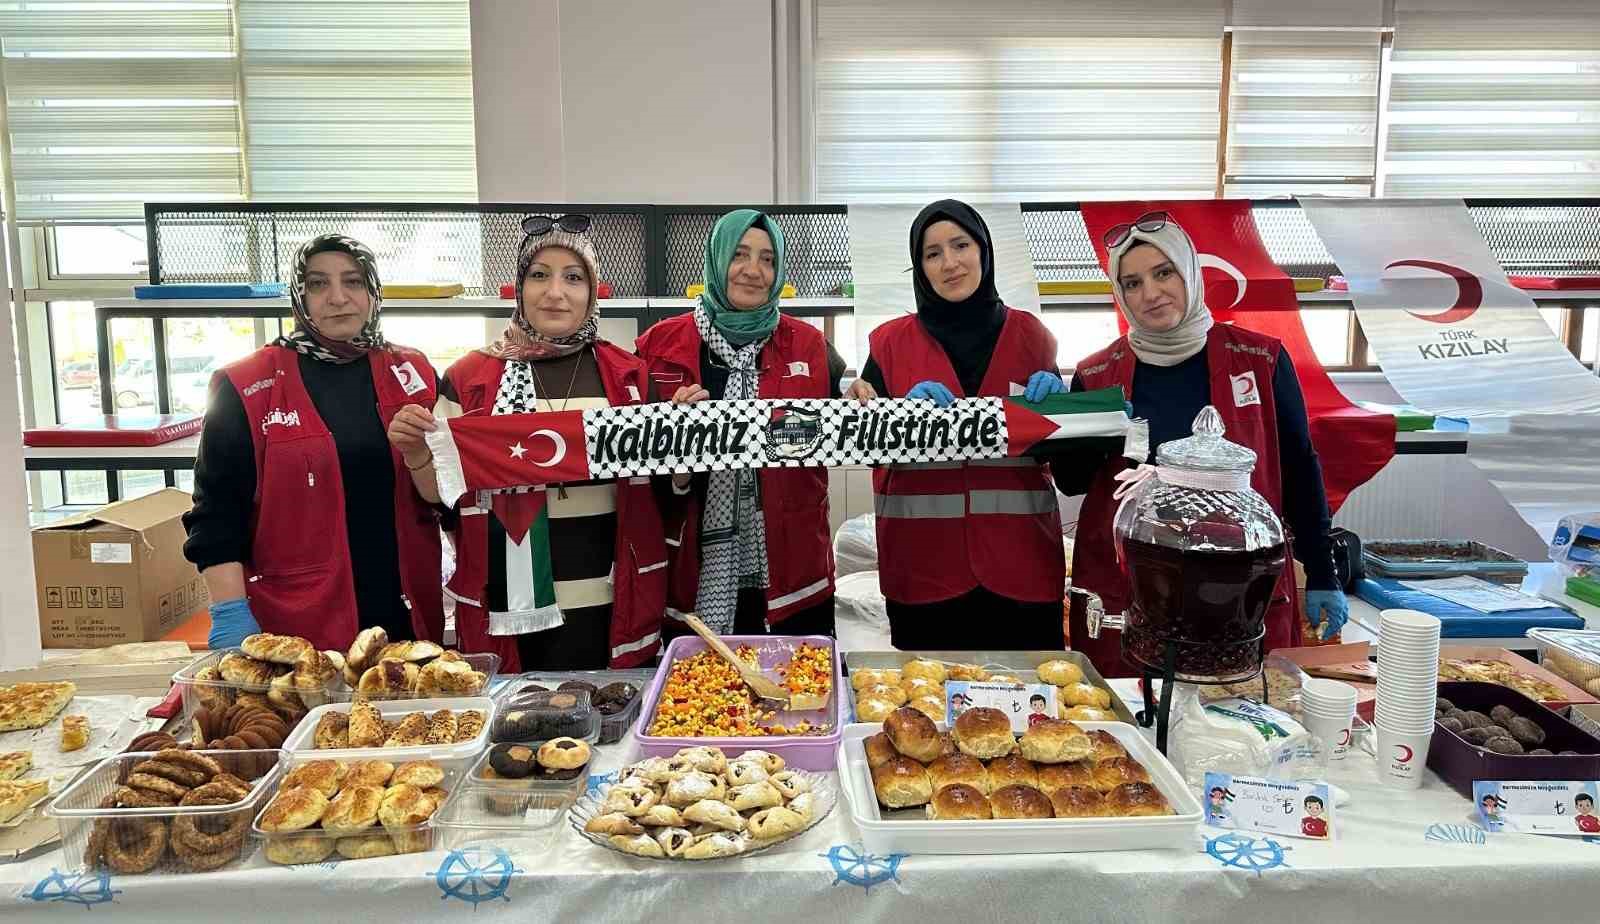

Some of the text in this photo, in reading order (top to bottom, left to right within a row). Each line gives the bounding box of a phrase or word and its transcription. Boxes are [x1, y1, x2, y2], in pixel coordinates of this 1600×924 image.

[1439, 328, 1478, 341] TÜRK
[1417, 338, 1509, 360] KIZILAY
[594, 409, 999, 464] Kalbimiz Filistin'de
